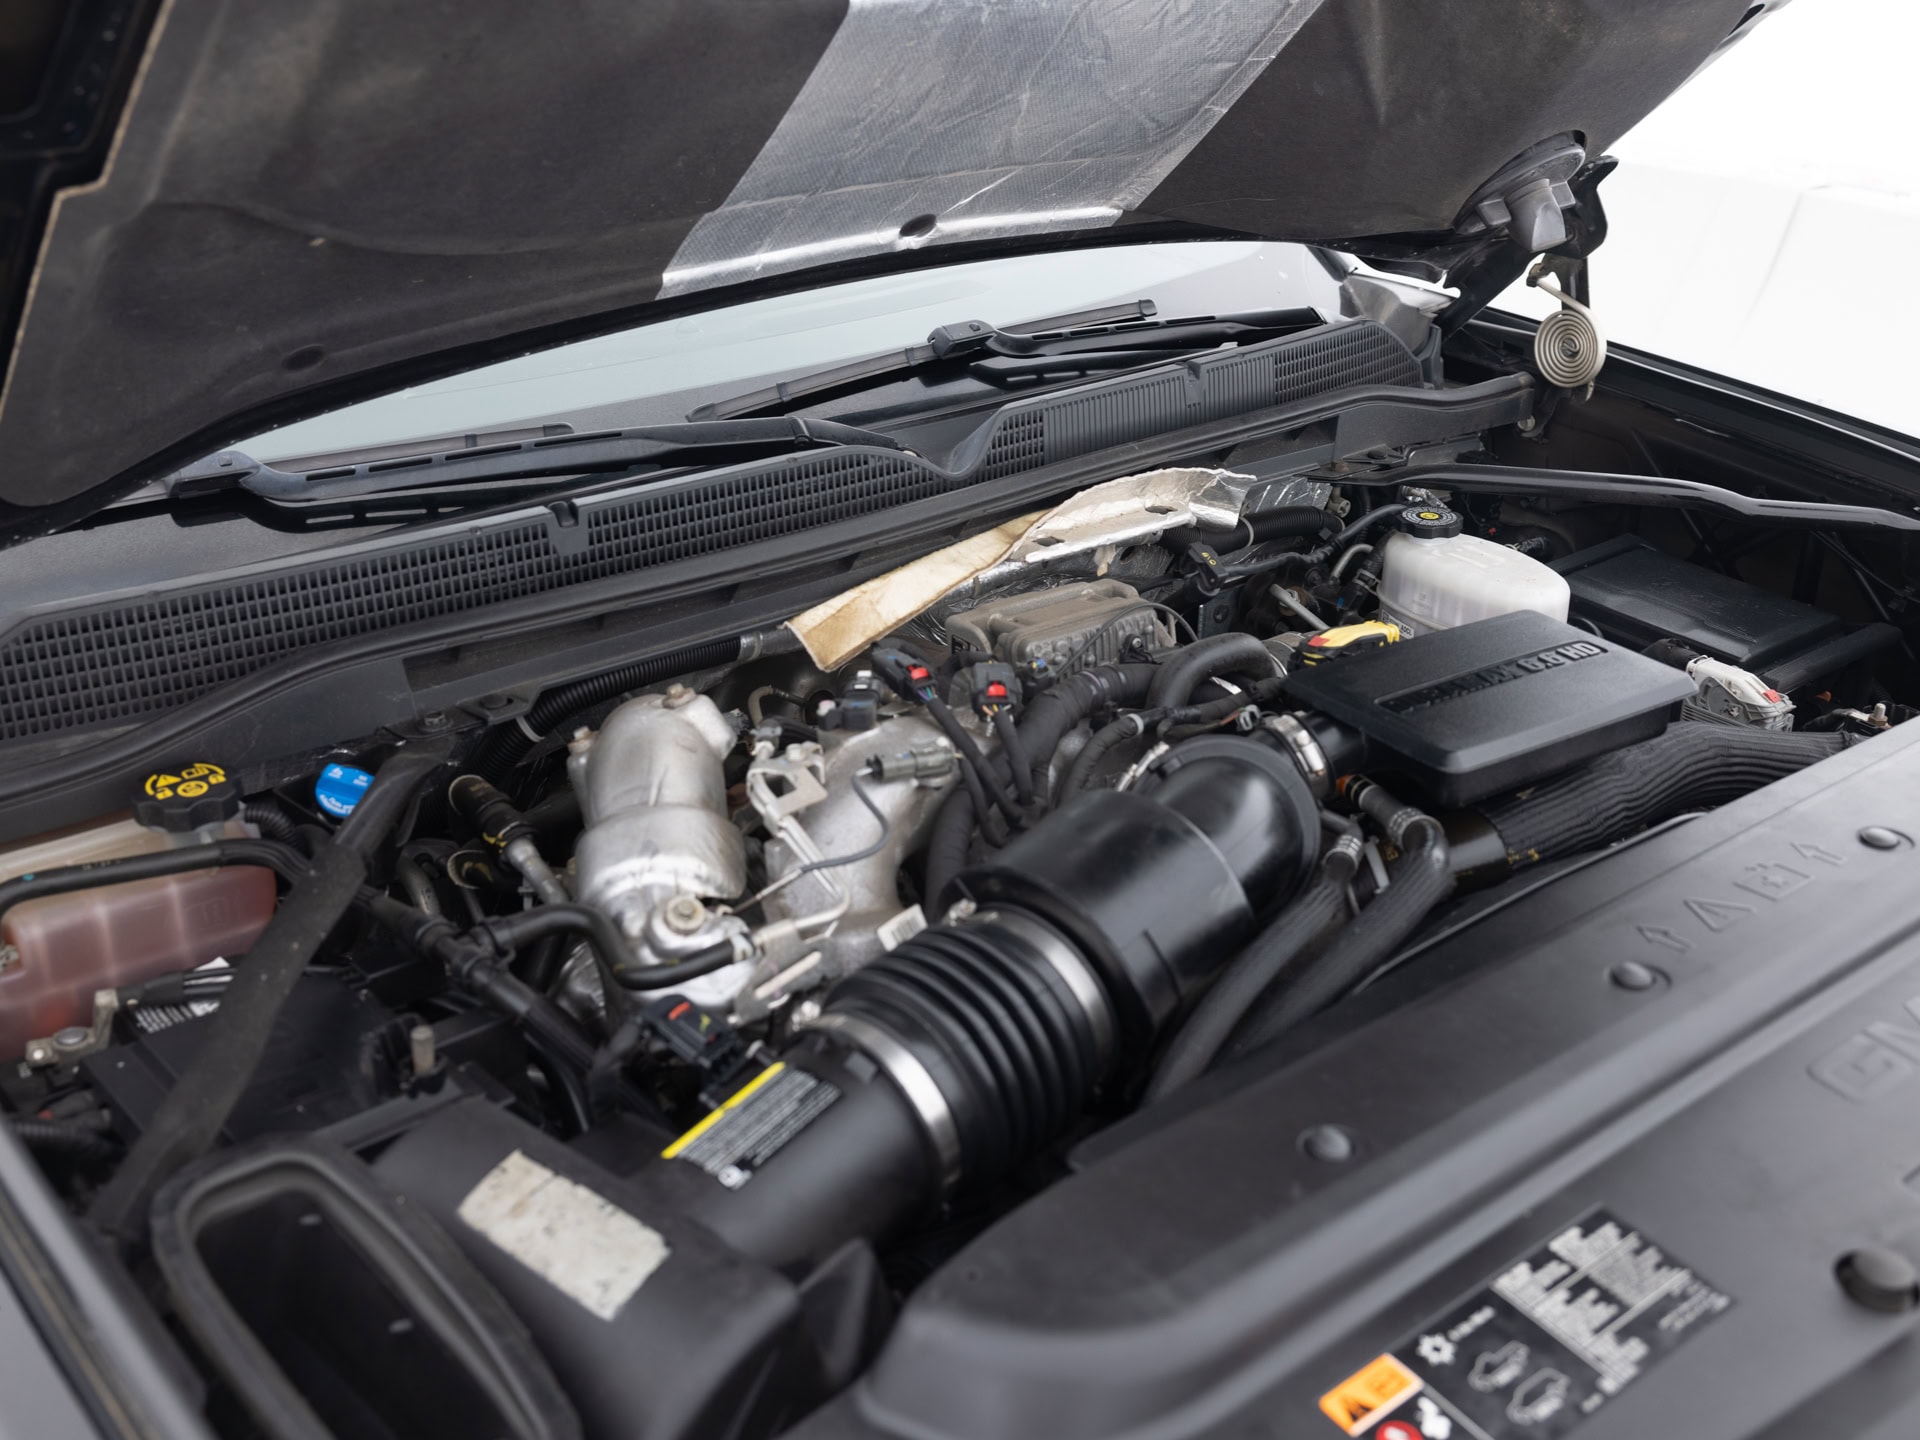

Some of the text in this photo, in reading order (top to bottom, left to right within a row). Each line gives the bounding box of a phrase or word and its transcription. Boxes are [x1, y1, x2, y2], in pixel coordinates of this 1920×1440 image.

[1380, 641, 1602, 713] RAMAX 6.6 HD
